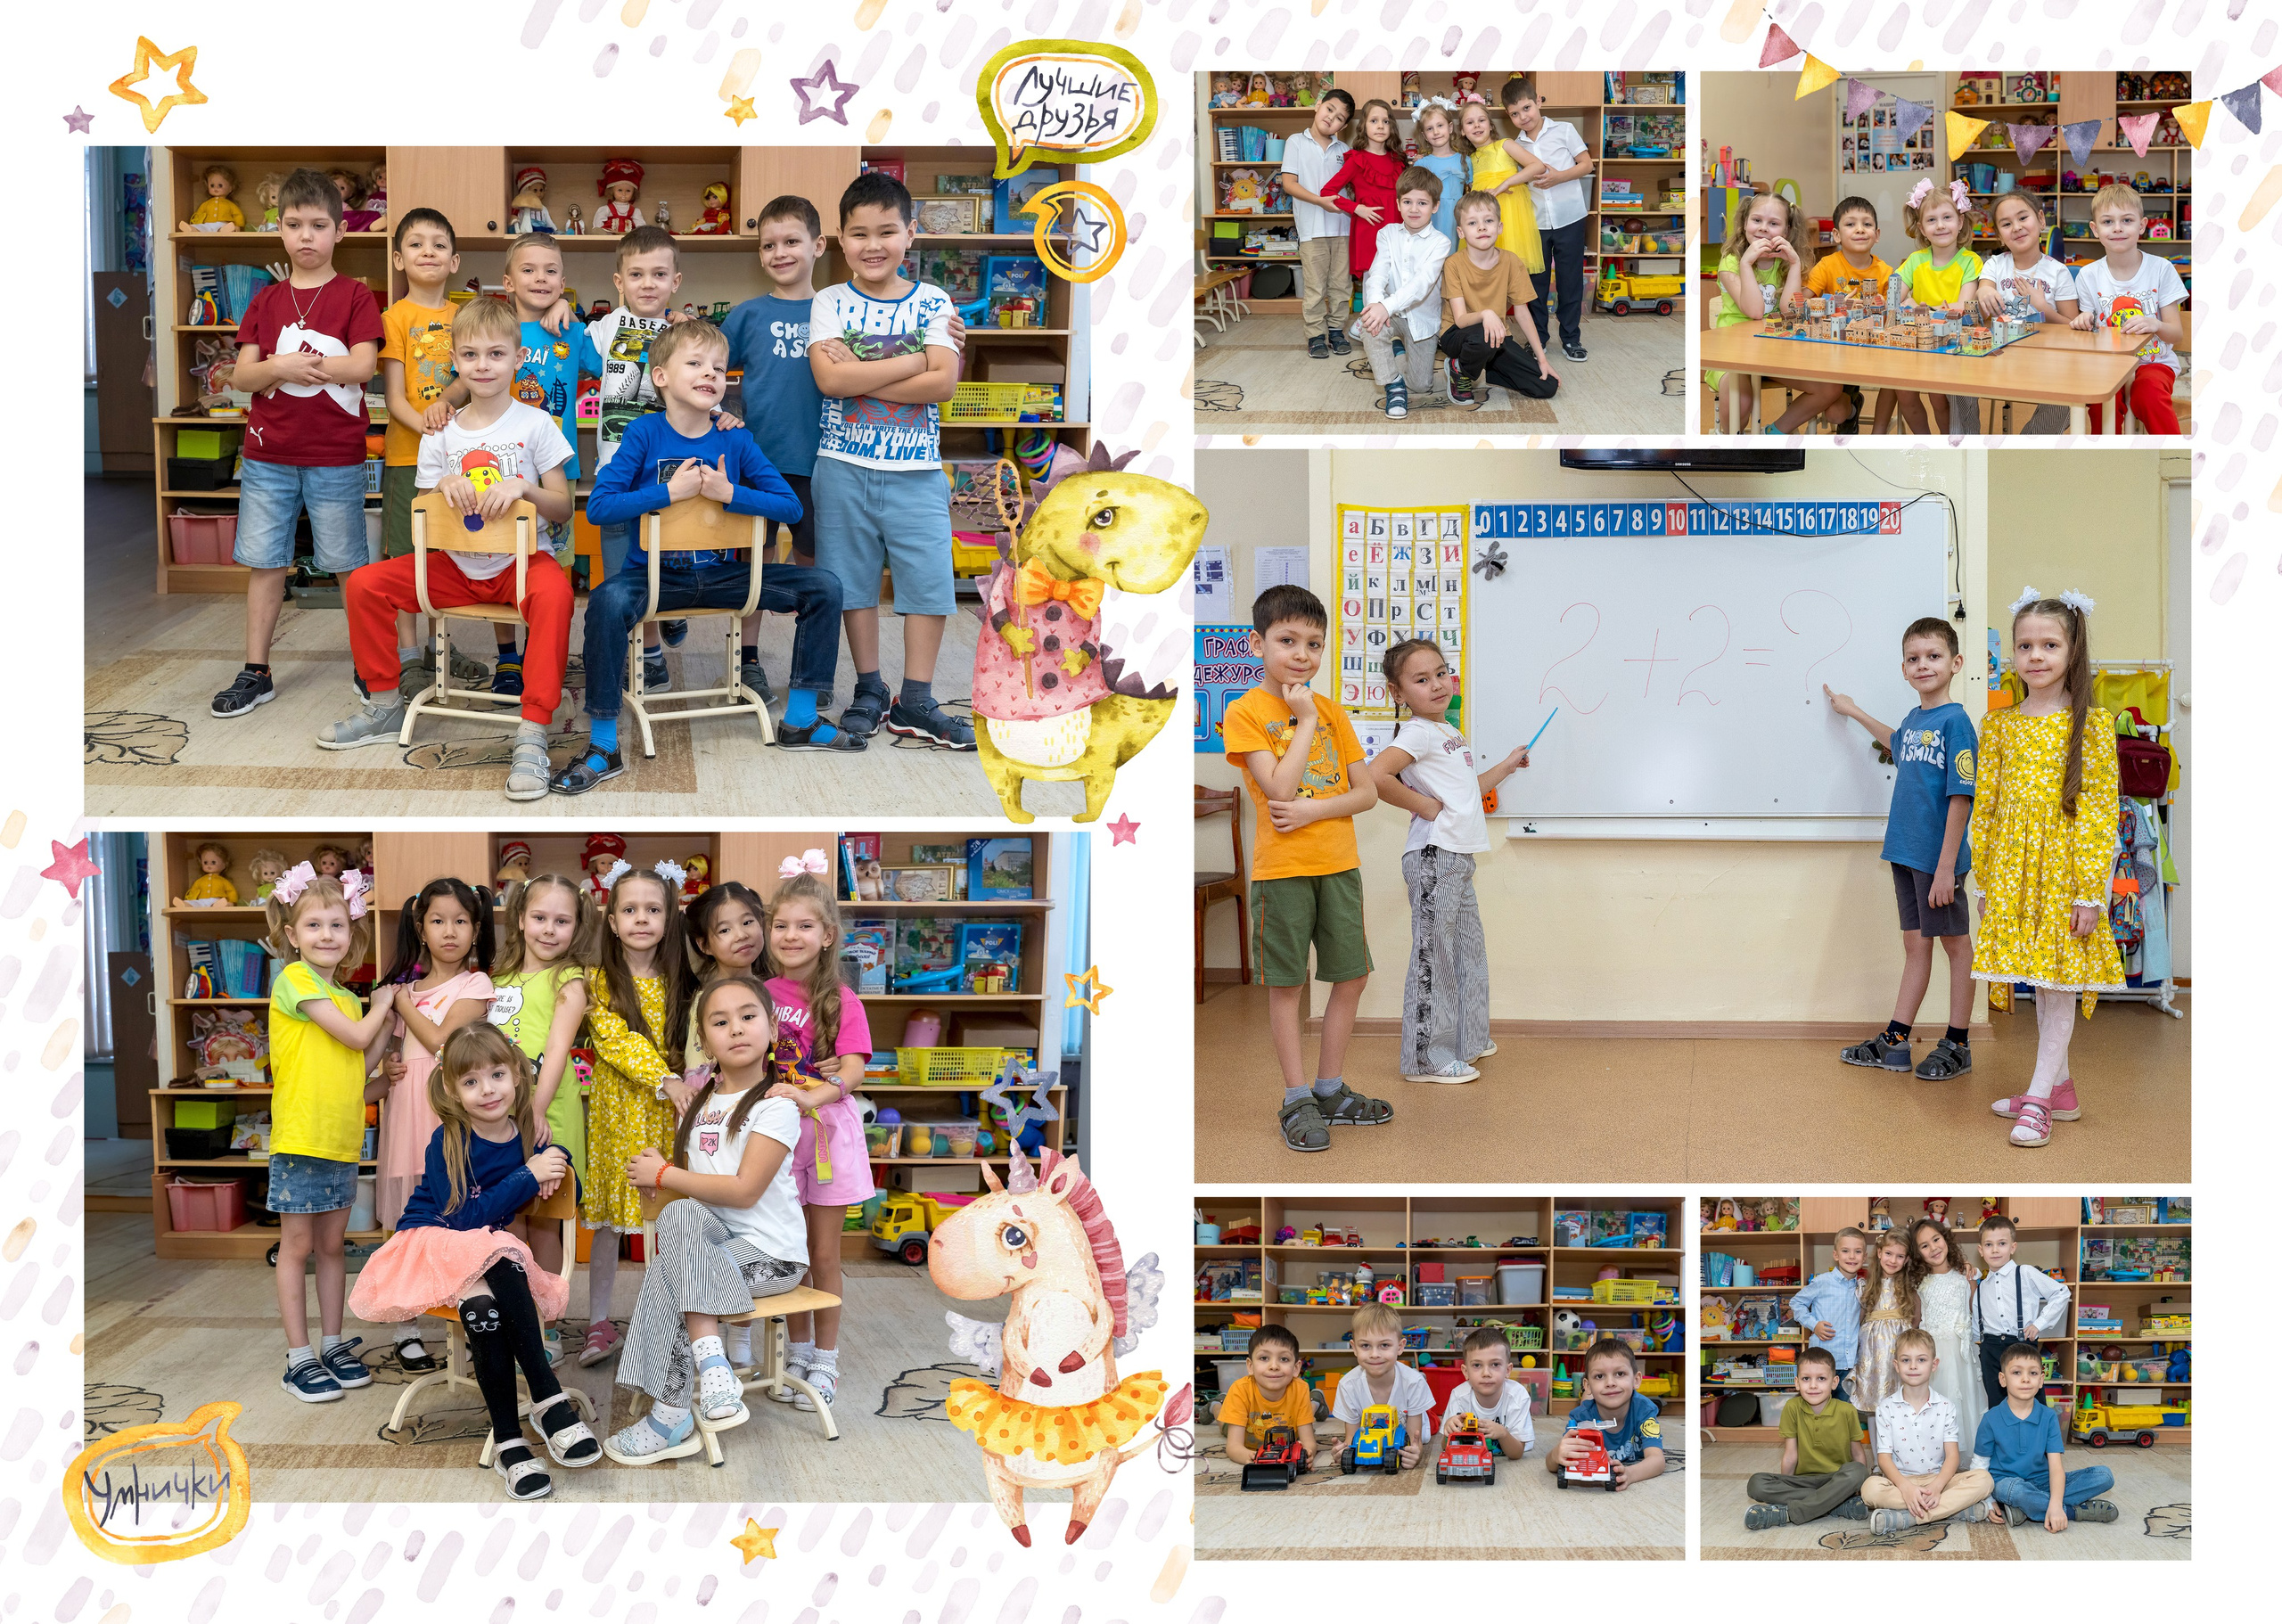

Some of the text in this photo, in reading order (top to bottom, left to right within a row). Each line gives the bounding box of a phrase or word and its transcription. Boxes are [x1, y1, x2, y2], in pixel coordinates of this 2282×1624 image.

[773, 339, 809, 358] A S
[606, 363, 625, 374] 1989
[884, 445, 928, 460] LIVE
[1370, 519, 1384, 535] Б
[1420, 519, 1434, 535] Г
[1443, 519, 1459, 541] Д
[1481, 508, 1900, 533] 0 1 2 3 4 5 6 7 8 9 10 11 12 13 14 15 16 17 18 19 20
[1369, 542, 1383, 563] Ё
[1444, 545, 1461, 562] И
[1369, 598, 1384, 618] П
[1203, 636, 1254, 657] ГРАФ
[1368, 630, 1386, 645] Ф
[1442, 630, 1458, 646] Ч
[1677, 605, 1730, 706] 2
[1344, 684, 1385, 701] Э Ю
[1906, 745, 1945, 769] SMILE
